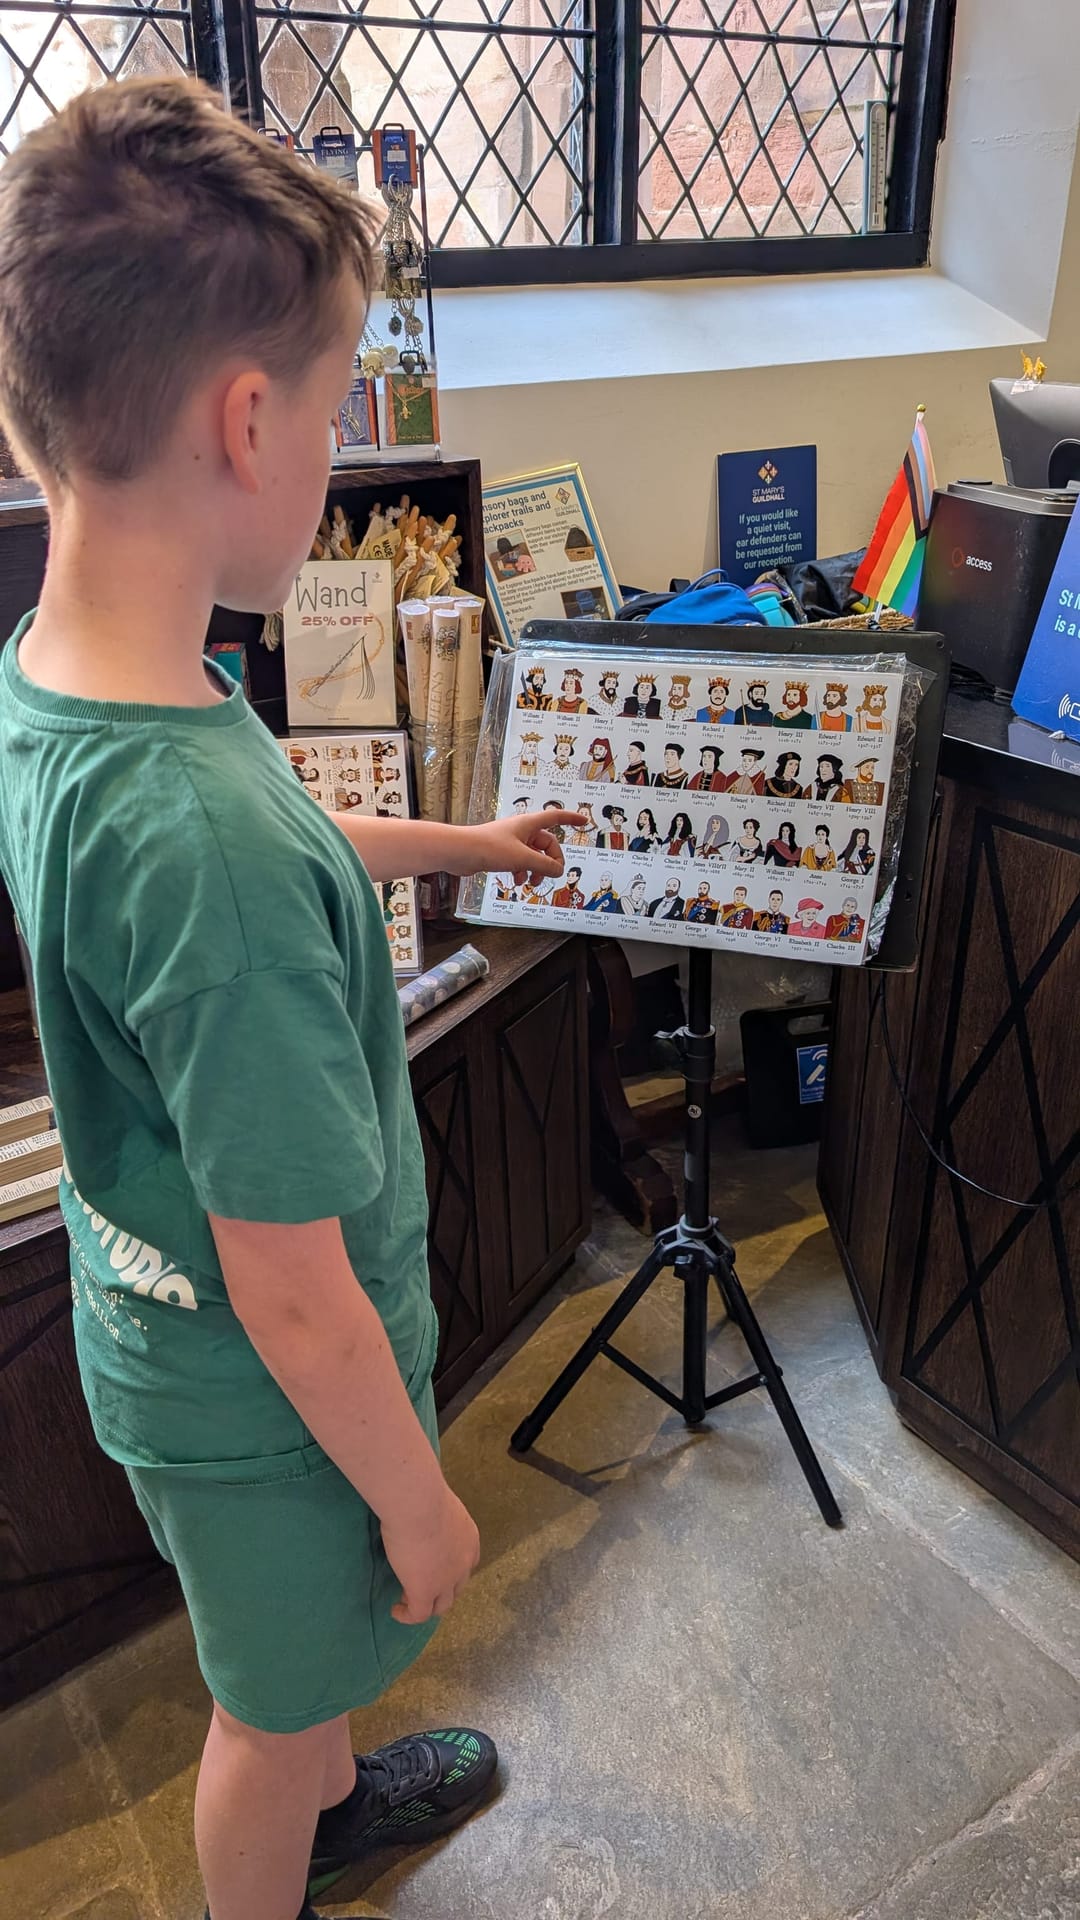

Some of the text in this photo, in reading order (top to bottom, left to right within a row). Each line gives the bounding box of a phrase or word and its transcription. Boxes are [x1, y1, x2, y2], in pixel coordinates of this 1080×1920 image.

[752, 486, 785, 497] ST MARY'S
[752, 493, 785, 504] GUILDHALL
[482, 490, 547, 512] nsory bags and
[511, 503, 534, 516] trails
[535, 500, 551, 512] and
[739, 508, 799, 525] If you would like
[484, 518, 524, 534] ackpacks
[747, 520, 791, 535] a quiet visit,
[736, 531, 802, 548] ear defenders can
[735, 543, 803, 560] be requested from
[744, 555, 795, 570] our reception.
[966, 555, 993, 571] access
[295, 571, 368, 612] Wand
[1059, 588, 1074, 608] St
[301, 616, 374, 627] 25% OFF
[1054, 615, 1066, 633] is
[1067, 623, 1075, 637] a
[856, 735, 876, 743] Edward
[620, 787, 635, 795] Henry
[655, 790, 670, 798] Henry
[766, 799, 787, 807] Richard
[806, 802, 823, 811] Henry
[845, 806, 862, 814] Henry
[840, 876, 860, 884] George
